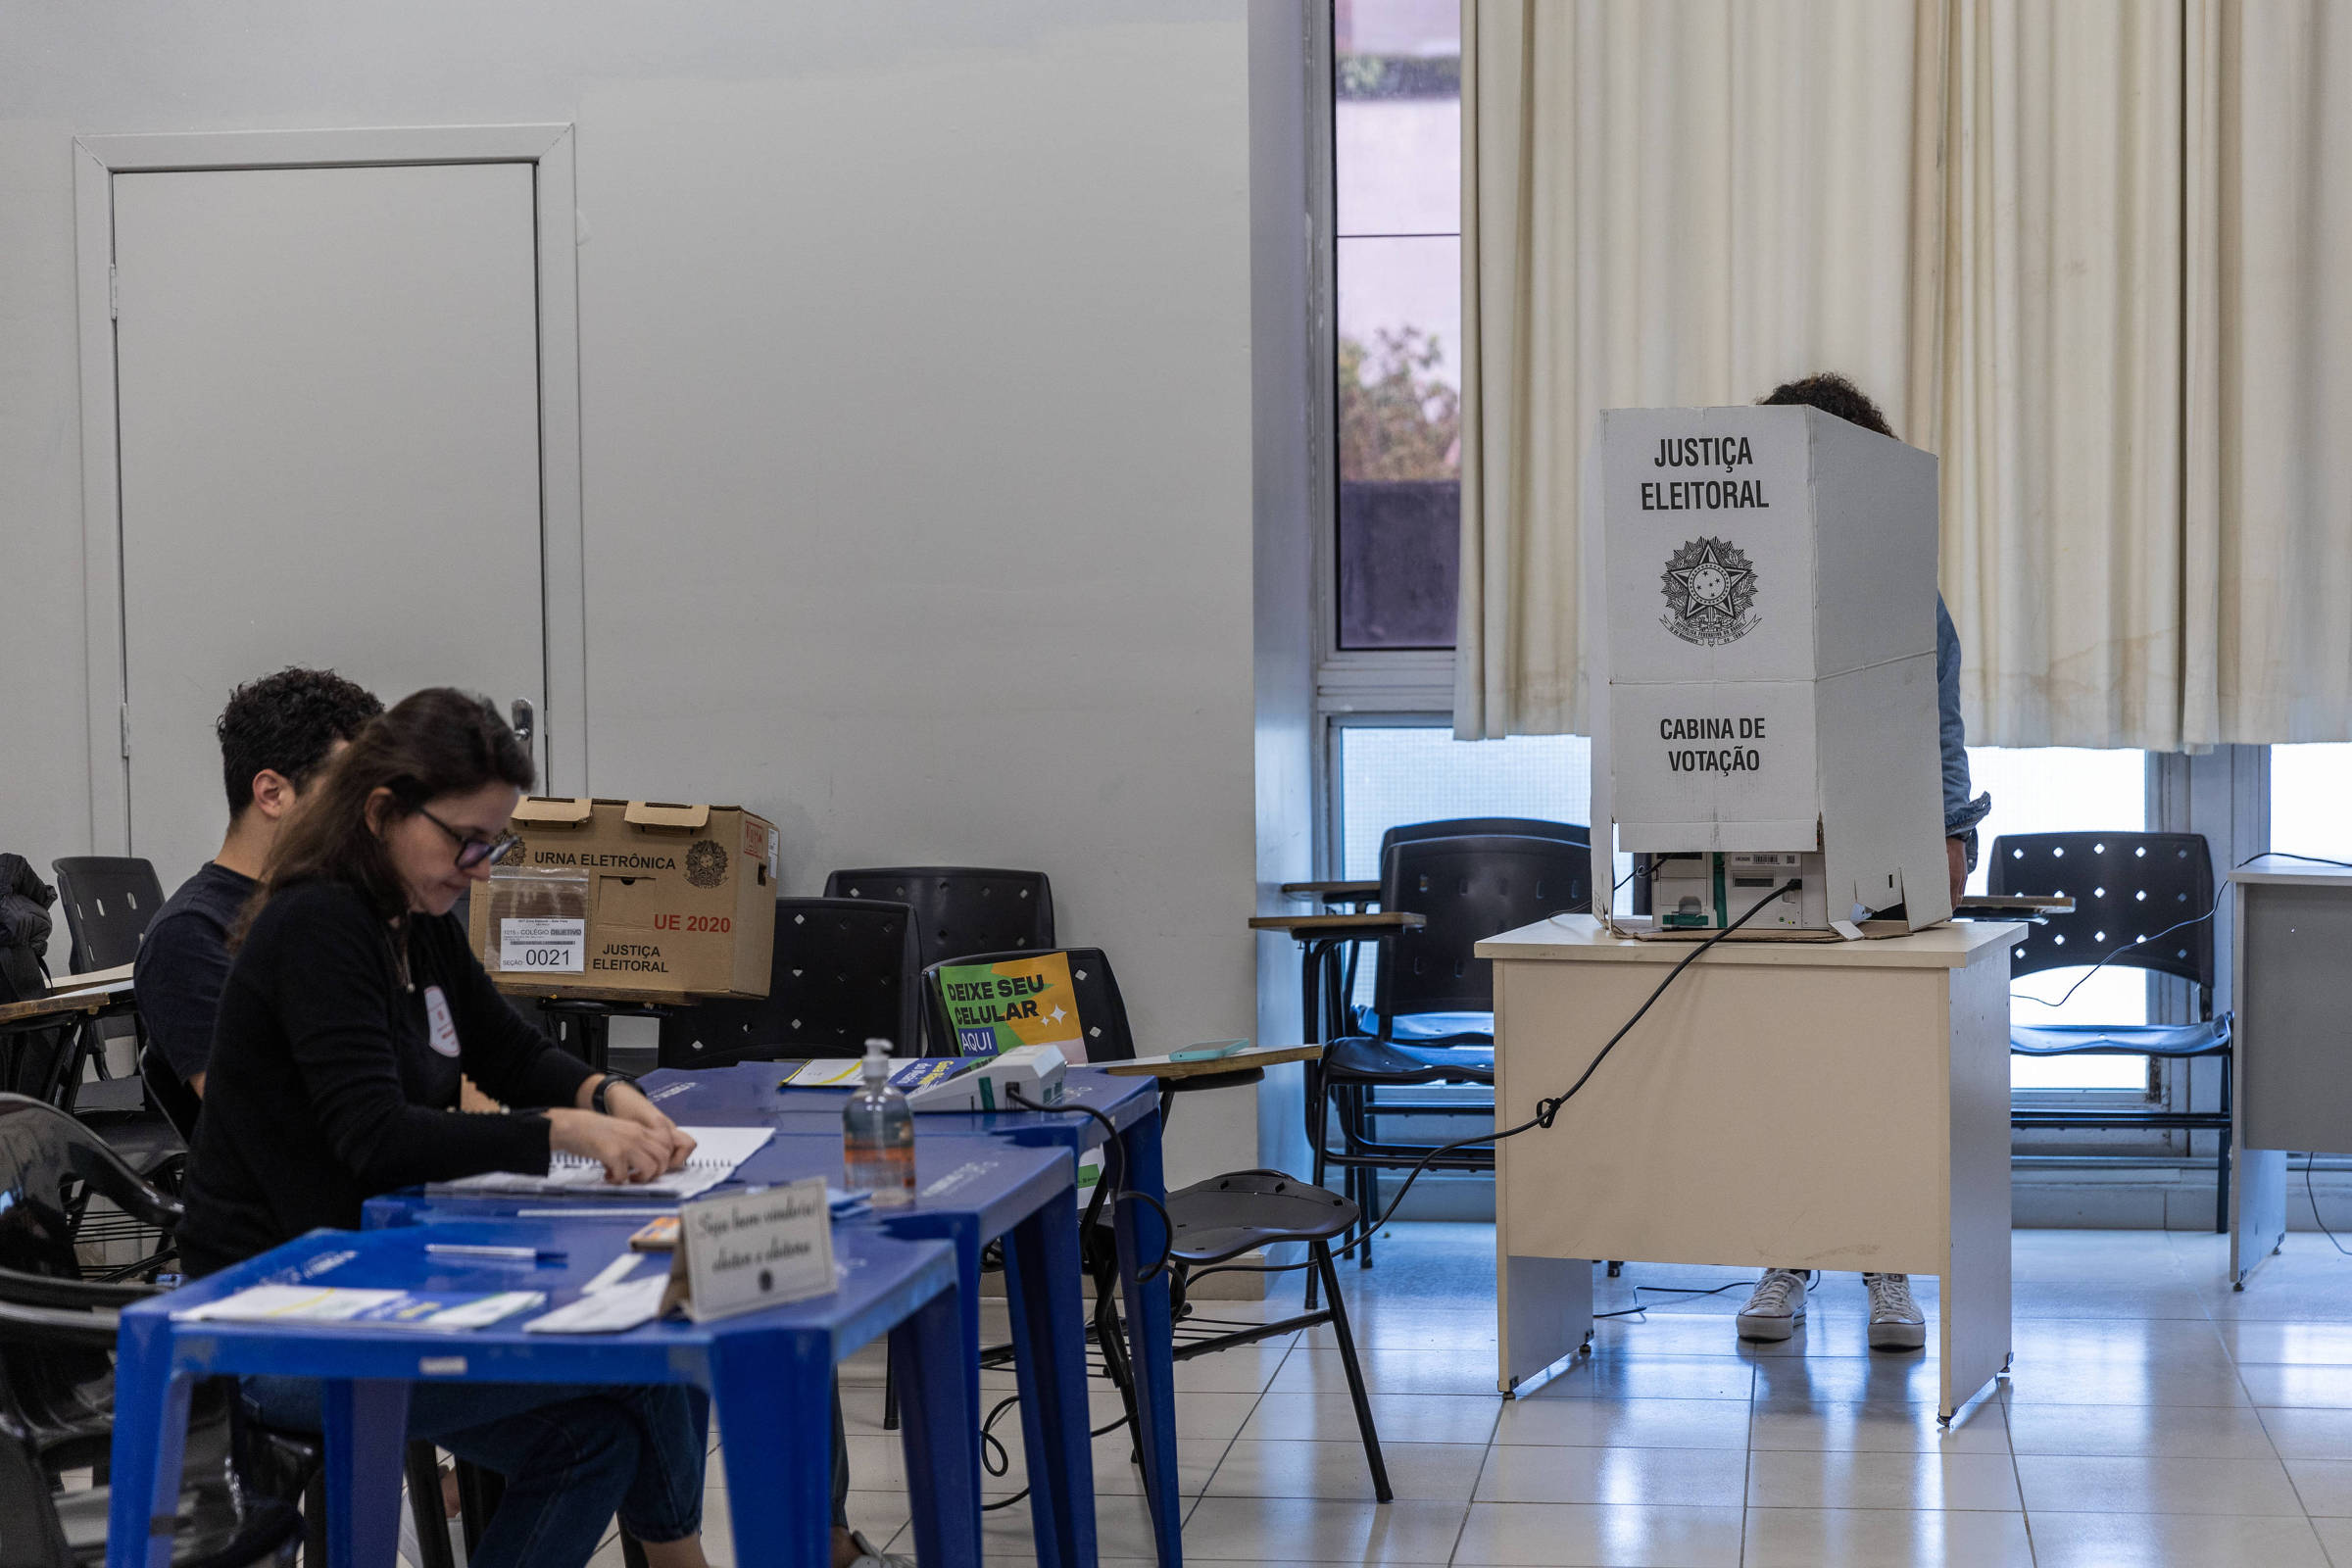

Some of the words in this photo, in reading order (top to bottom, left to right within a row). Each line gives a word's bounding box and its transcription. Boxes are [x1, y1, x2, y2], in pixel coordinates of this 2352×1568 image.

[1654, 437, 1752, 472] JUSTIÇA
[1642, 480, 1769, 511] ELEITORAL
[1660, 718, 1733, 739] CABINA
[1740, 717, 1765, 738] DE
[1668, 746, 1759, 775] VOTAÇÃO
[534, 852, 576, 865] URNA
[580, 851, 676, 870] ELETRÔNICA
[654, 914, 681, 930] UE
[687, 916, 731, 933] 2020
[525, 949, 569, 965] 0021
[603, 944, 661, 957] JUSTIÇA
[593, 959, 669, 973] ELEITORAL
[947, 982, 994, 1002] DEIXE
[998, 974, 1045, 998] SEU
[955, 1000, 1040, 1025] CELULAR
[961, 1032, 992, 1052] AQUI
